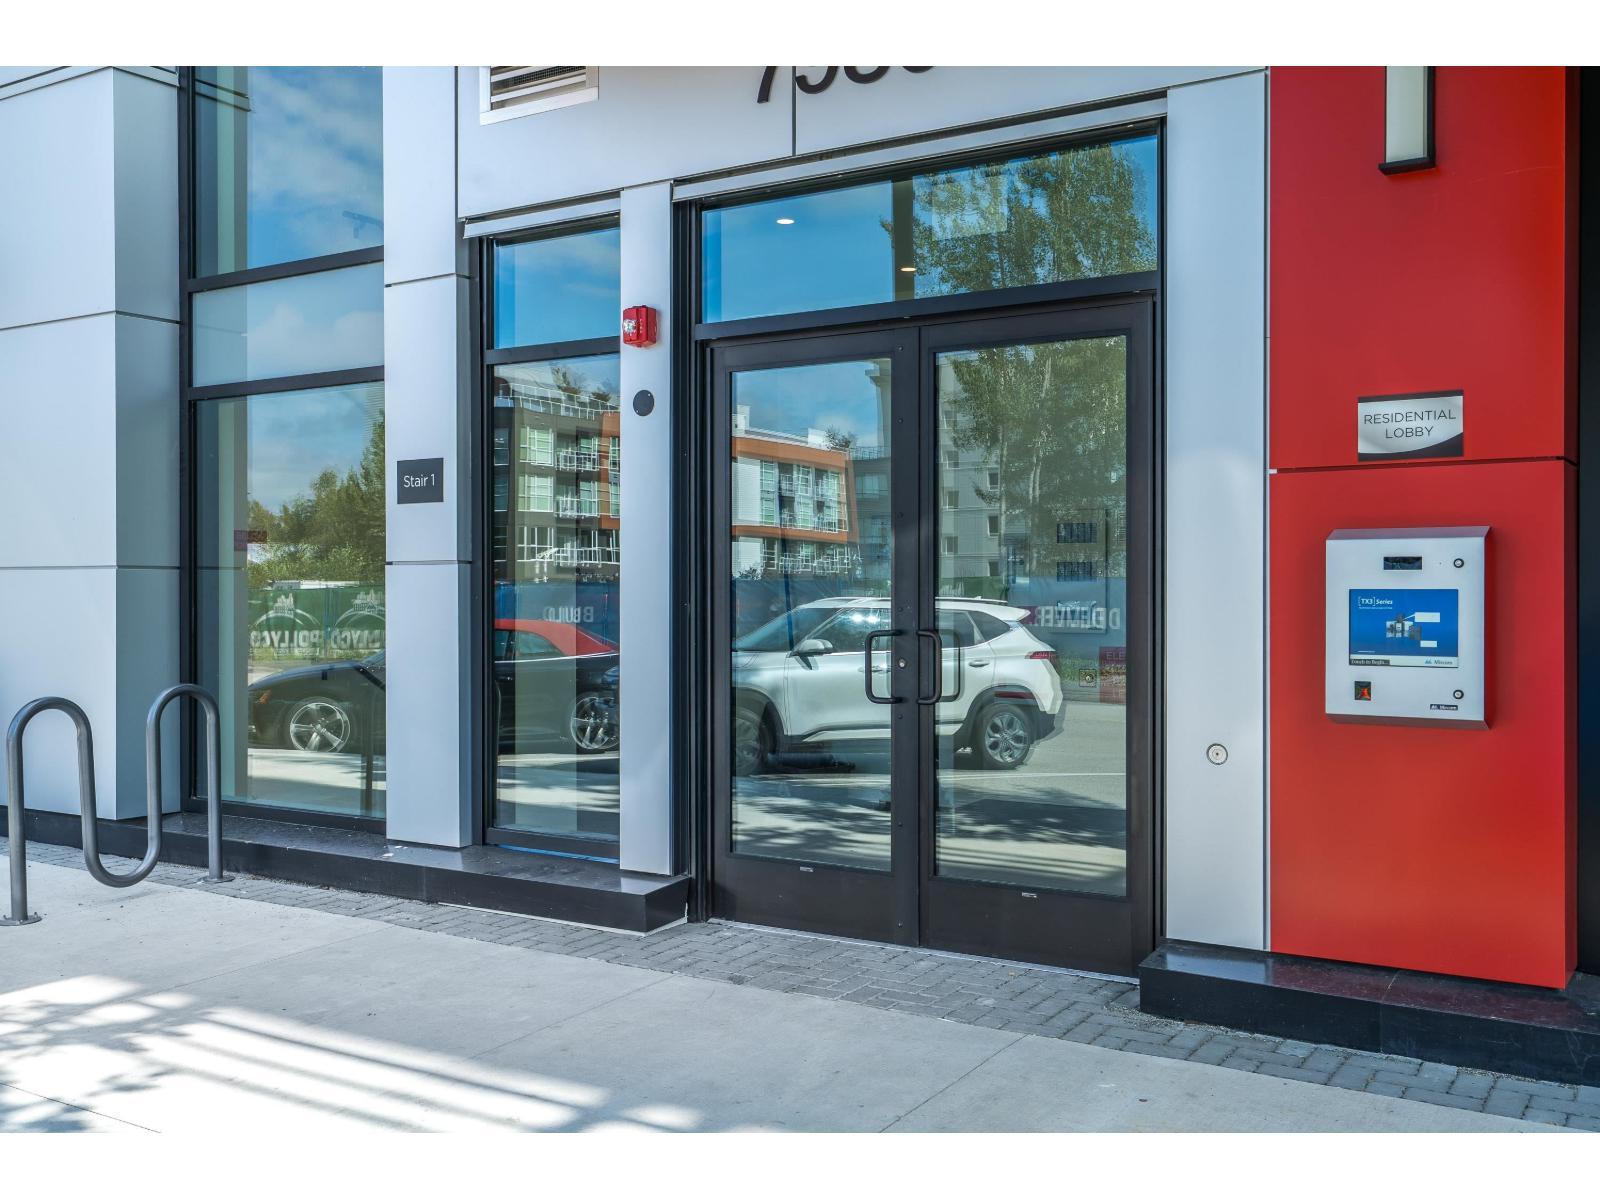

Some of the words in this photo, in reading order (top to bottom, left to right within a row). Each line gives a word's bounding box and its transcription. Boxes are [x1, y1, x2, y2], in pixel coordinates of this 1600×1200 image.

[1364, 409, 1456, 424] RESIDENTIAL
[1385, 426, 1434, 439] LOBBY
[403, 474, 428, 488] Stair
[430, 473, 435, 487] 1
